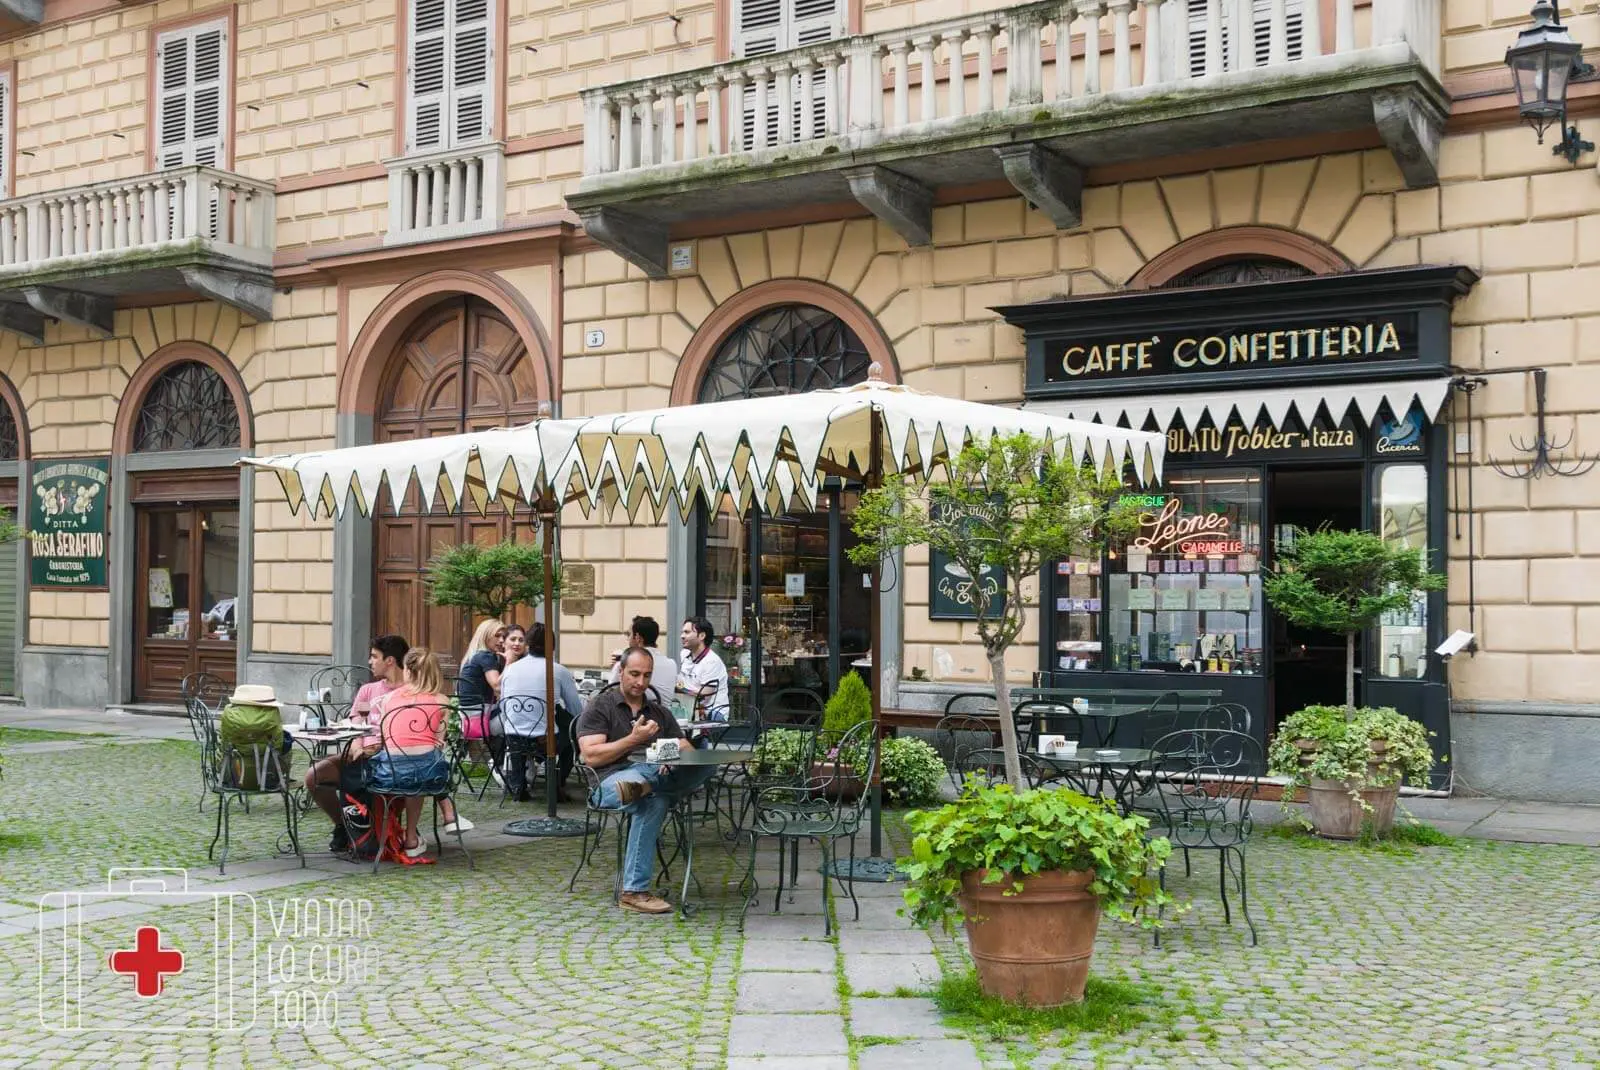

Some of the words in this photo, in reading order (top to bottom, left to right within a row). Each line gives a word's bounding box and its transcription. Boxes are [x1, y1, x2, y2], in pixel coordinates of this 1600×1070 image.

[1173, 322, 1401, 367] CONFETTERIA
[1224, 426, 1300, 458] Tobler
[1301, 433, 1310, 448] in
[1313, 427, 1354, 447] tazza
[1376, 436, 1421, 454] Bicerin
[53, 520, 79, 528] DITTA
[1134, 498, 1229, 548] Leone
[32, 529, 56, 557] ROSA
[57, 529, 104, 558] SERAFINO
[1181, 541, 1245, 553] CARAMELLE
